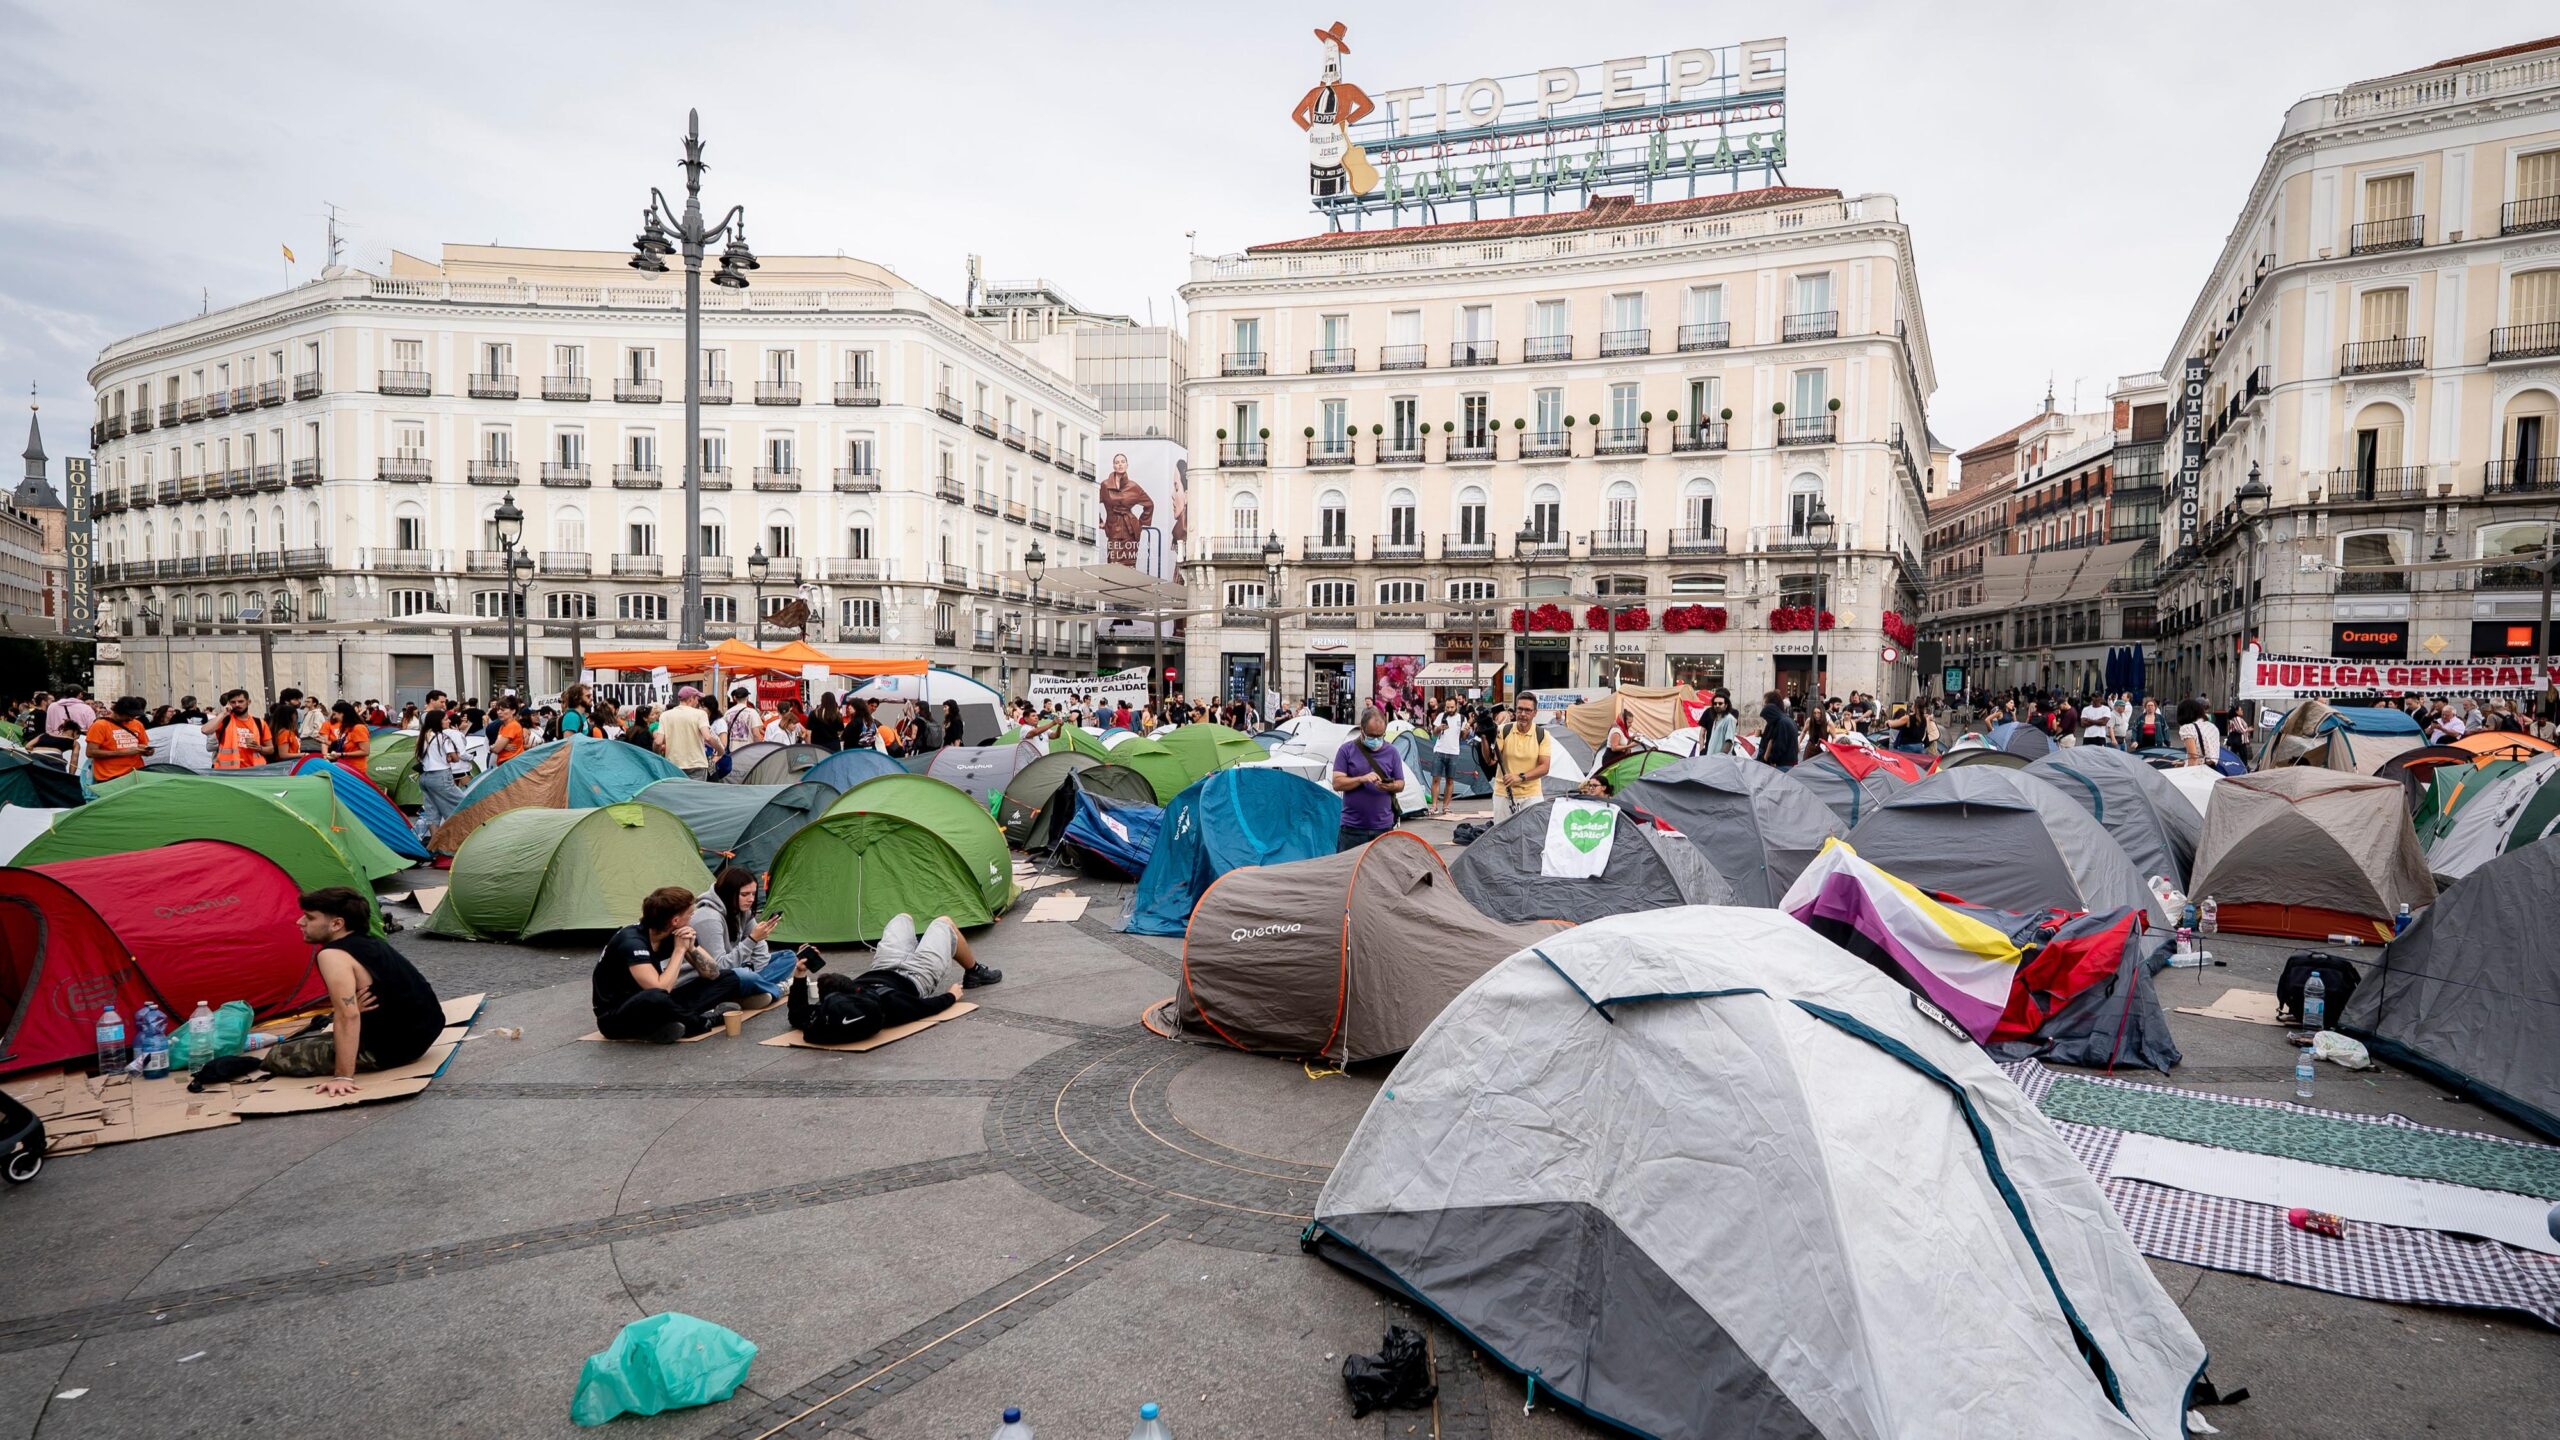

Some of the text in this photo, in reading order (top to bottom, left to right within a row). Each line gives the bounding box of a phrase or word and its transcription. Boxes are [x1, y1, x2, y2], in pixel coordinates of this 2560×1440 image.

[1384, 37, 1788, 137] TIO PEPE
[1380, 147, 1424, 165] SOL
[1431, 142, 1458, 159] DE
[1602, 102, 1784, 138] EMBOTELLADO
[1384, 128, 1788, 204] GONZALEZ BYASS
[2180, 367, 2203, 546] HOTEL EUROPA
[69, 458, 90, 620] HOTEL MODERNO
[1311, 637, 1348, 646] PRIMOR
[2342, 630, 2398, 645] Orange
[1774, 644, 1825, 653] SEPHOA
[1038, 676, 1079, 684] VIVIENDA
[2256, 663, 2380, 688] HUELGA
[2387, 665, 2536, 687] GENERAL
[593, 683, 657, 706] CONTRA
[1032, 687, 1073, 695] GRATUITA
[1084, 686, 1099, 694] DE
[1101, 682, 1147, 692] CALIDAD
[1570, 822, 1609, 831] Sanidad
[1231, 923, 1302, 942] Quechua
[1919, 1002, 1941, 1018] FRESH
